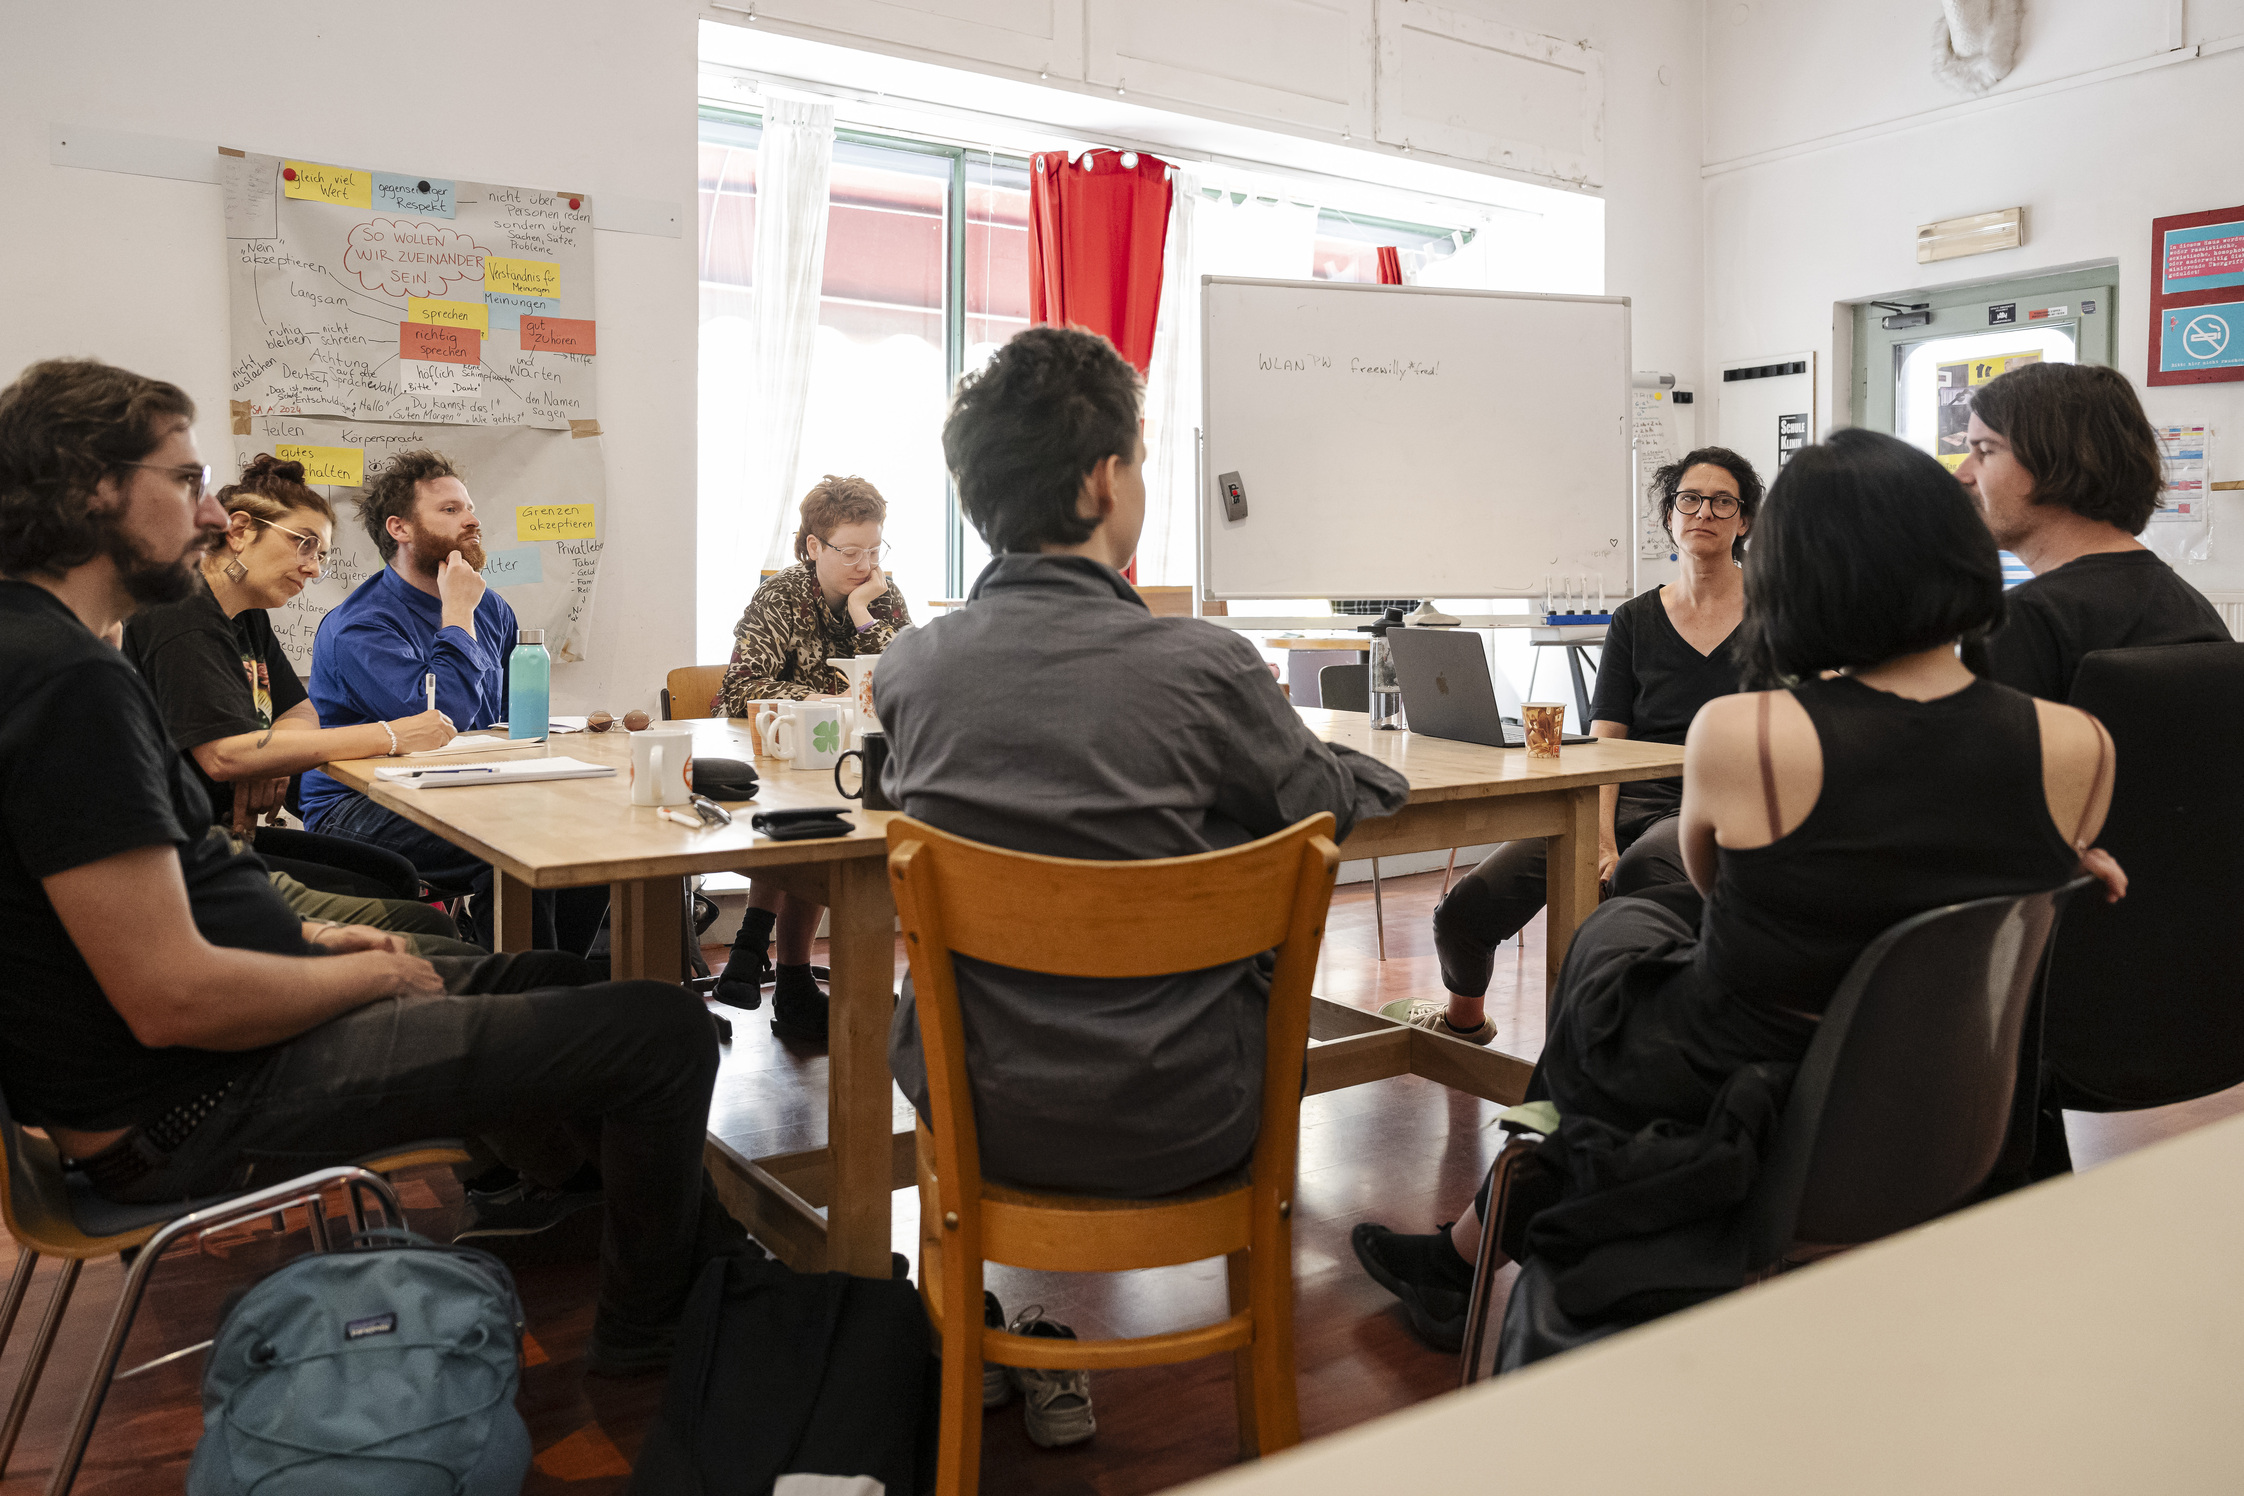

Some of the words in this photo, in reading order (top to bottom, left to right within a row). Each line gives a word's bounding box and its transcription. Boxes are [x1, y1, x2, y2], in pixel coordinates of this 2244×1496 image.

[293, 170, 325, 189] gleich
[334, 173, 355, 187] viel
[320, 184, 349, 200] Wert
[489, 190, 521, 203] nicht
[529, 193, 557, 207] über
[396, 197, 447, 214] Respekt
[505, 203, 559, 220] Personen
[564, 210, 591, 224] reden
[494, 219, 545, 231] sondern
[552, 222, 577, 235] über
[362, 227, 385, 242] SO
[394, 232, 446, 247] WOLLEN
[510, 239, 554, 256] Probleme
[241, 253, 327, 274] akzeptieren
[355, 248, 394, 262] WIR
[398, 250, 486, 270] ZUEINANDER
[488, 262, 541, 282] Verständnis
[543, 269, 555, 286] für
[512, 282, 550, 297] Meinungen
[484, 293, 546, 316] Meinungen
[422, 308, 469, 325] sprechen
[268, 322, 304, 338] ruhig
[322, 321, 350, 334] nicht
[526, 319, 546, 336] gut
[265, 334, 312, 350] bleiben
[321, 334, 367, 345] schreien
[415, 329, 457, 349] richtig
[534, 329, 577, 346] zuhören
[309, 347, 370, 374] Achtung
[420, 344, 467, 360] sprechen
[231, 353, 258, 379] nicht
[516, 356, 535, 367] und
[1258, 352, 1305, 372] WLAN
[1306, 352, 1333, 369] PW
[233, 356, 277, 392] auslachen
[282, 363, 330, 388] Deutsch
[336, 368, 355, 378] auf
[416, 365, 455, 384] höflich
[432, 396, 467, 411] kannst
[469, 400, 488, 414] das
[525, 391, 540, 405] den
[543, 390, 581, 408] Namen
[279, 405, 302, 415] 2024
[532, 407, 567, 420] sagen
[262, 420, 304, 437] teilen
[341, 429, 424, 448] Körpersprache
[281, 448, 314, 461] gutes
[522, 506, 580, 518] Grenzen
[529, 517, 593, 533] akzeptieren
[273, 623, 297, 643] auf
